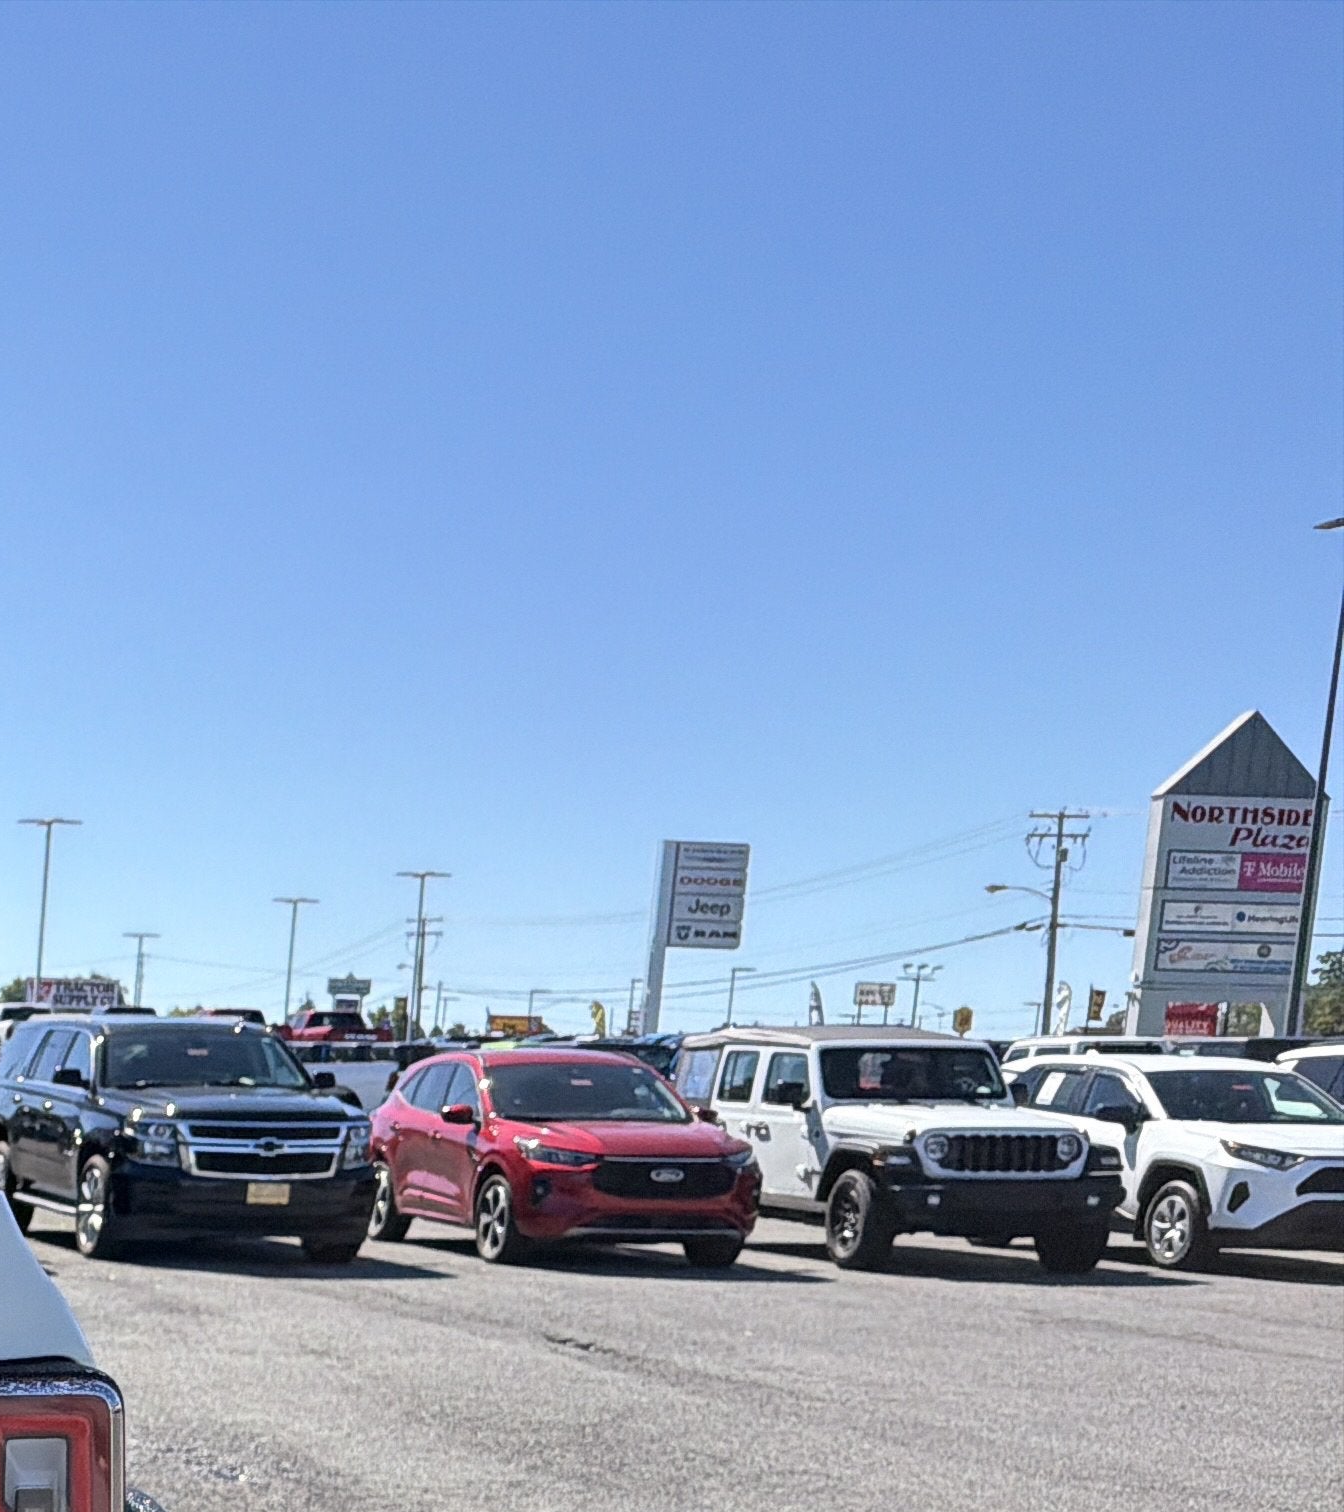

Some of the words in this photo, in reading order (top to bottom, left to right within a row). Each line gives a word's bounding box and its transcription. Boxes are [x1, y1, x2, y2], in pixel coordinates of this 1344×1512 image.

[1171, 801, 1312, 827] NORTHSIDE
[1229, 826, 1309, 850] Plaza
[688, 898, 731, 917] Jeep
